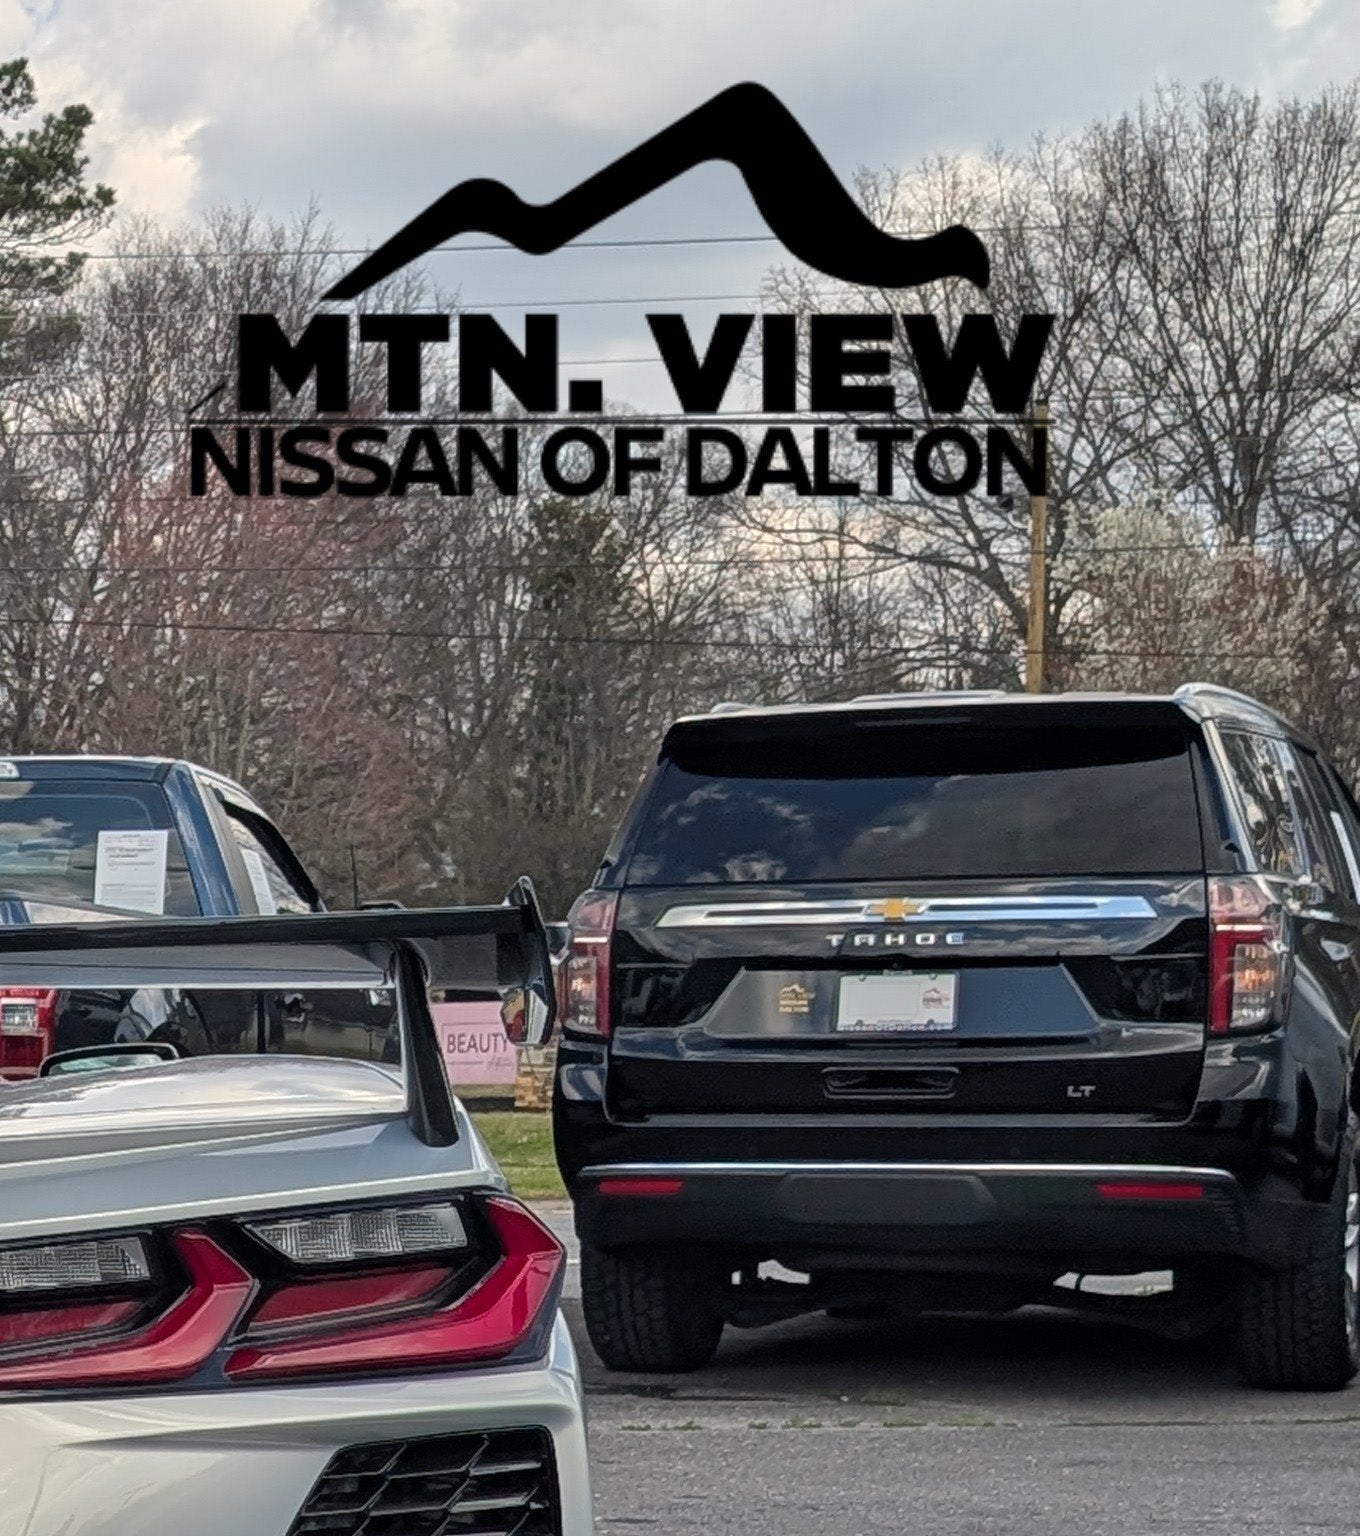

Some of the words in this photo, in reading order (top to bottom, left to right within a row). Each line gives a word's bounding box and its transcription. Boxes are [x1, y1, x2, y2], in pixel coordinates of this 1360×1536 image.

[825, 932, 966, 947] TAHOE
[447, 1033, 508, 1053] BEAUTY
[1067, 1085, 1096, 1097] LT
